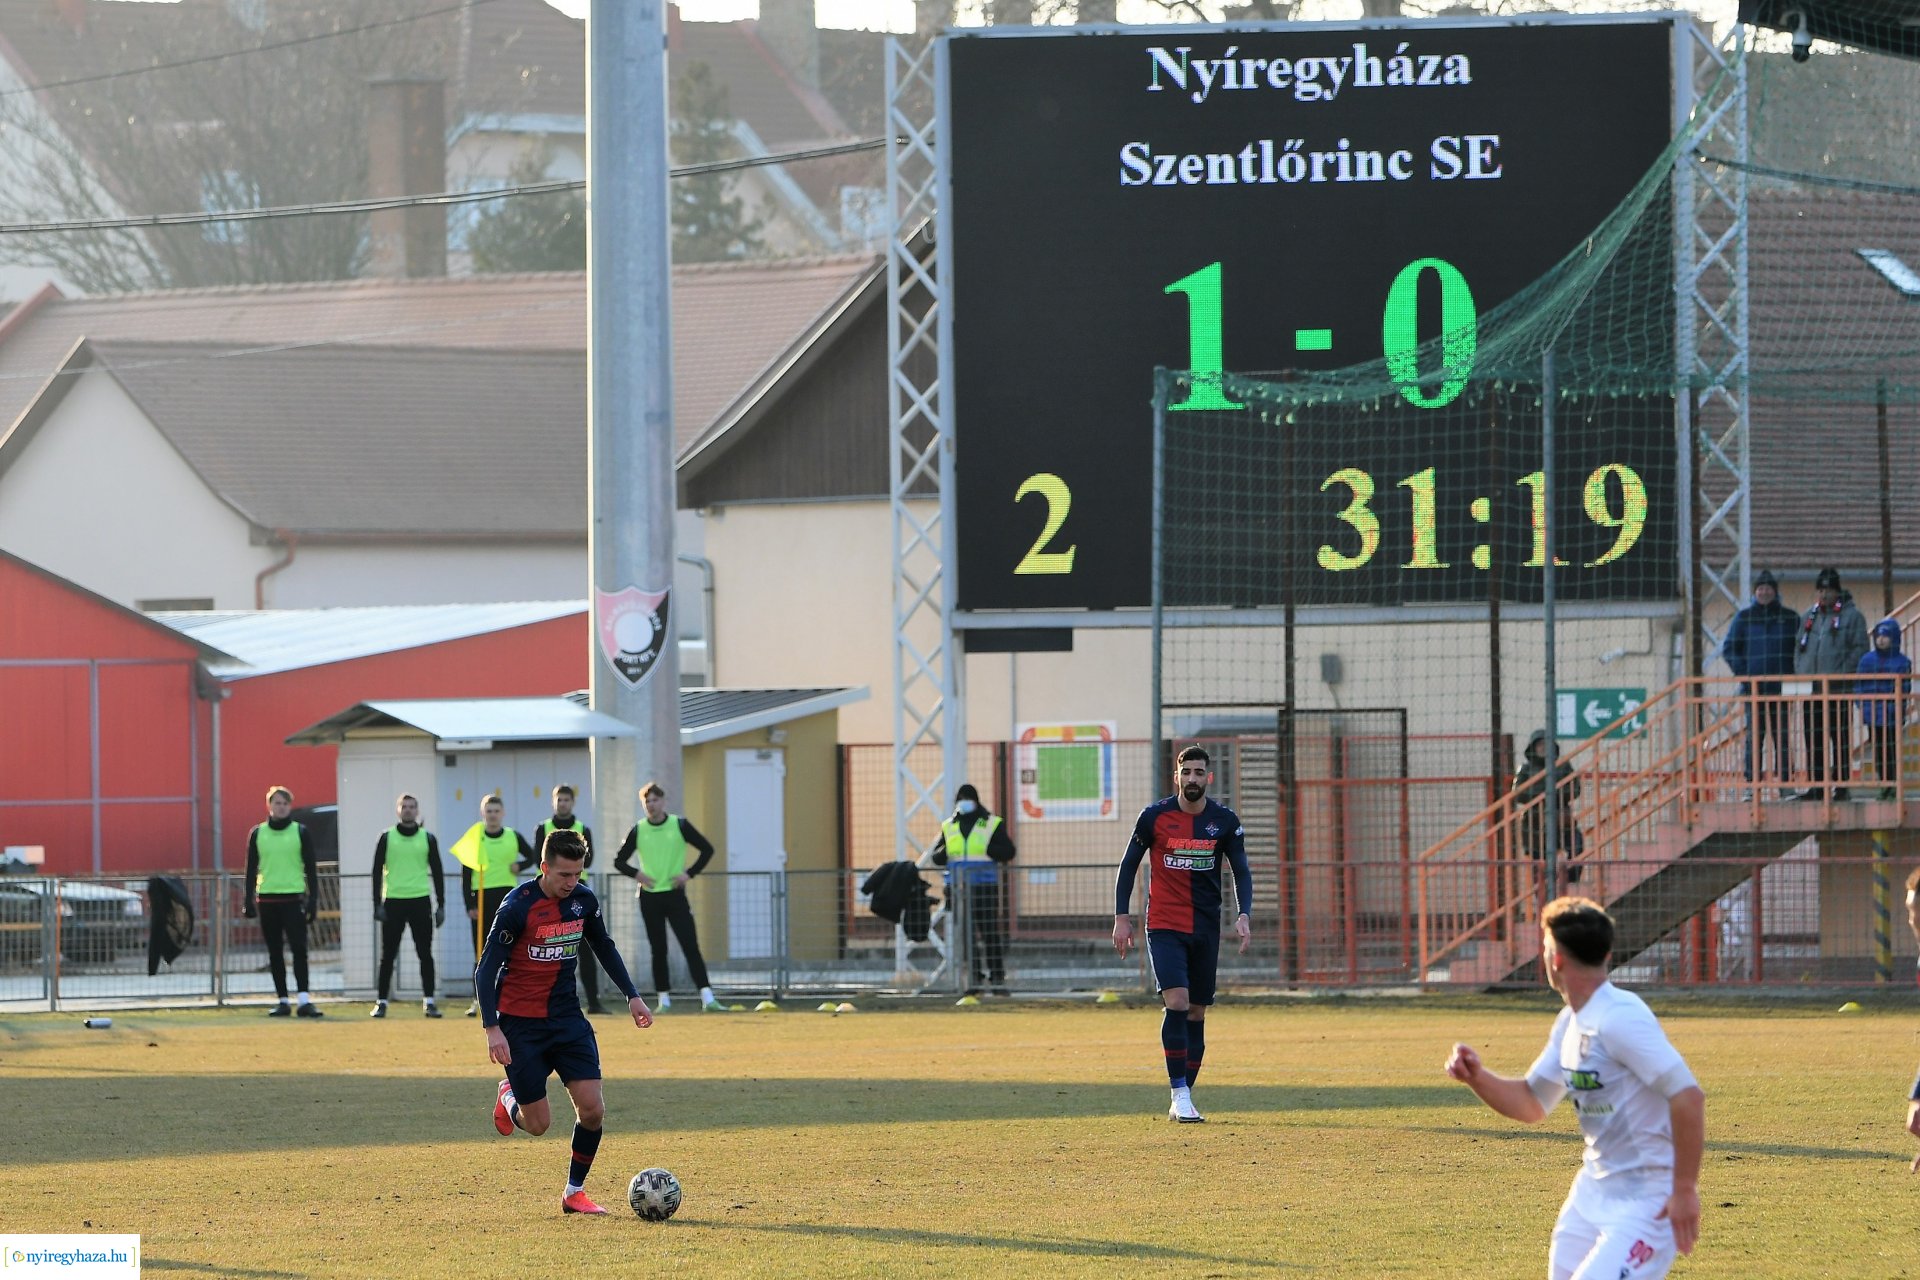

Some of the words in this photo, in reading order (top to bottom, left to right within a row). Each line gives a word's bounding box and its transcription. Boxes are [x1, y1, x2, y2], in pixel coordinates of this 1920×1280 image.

[1146, 42, 1473, 103] Nyíregyháza
[1119, 138, 1414, 186] Szentlőrinc
[1430, 134, 1503, 181] SE
[1163, 261, 1245, 411] 1
[1295, 328, 1333, 351] -
[1382, 256, 1477, 410] 0
[1013, 472, 1077, 575] 2
[1316, 462, 1648, 572] 31:19
